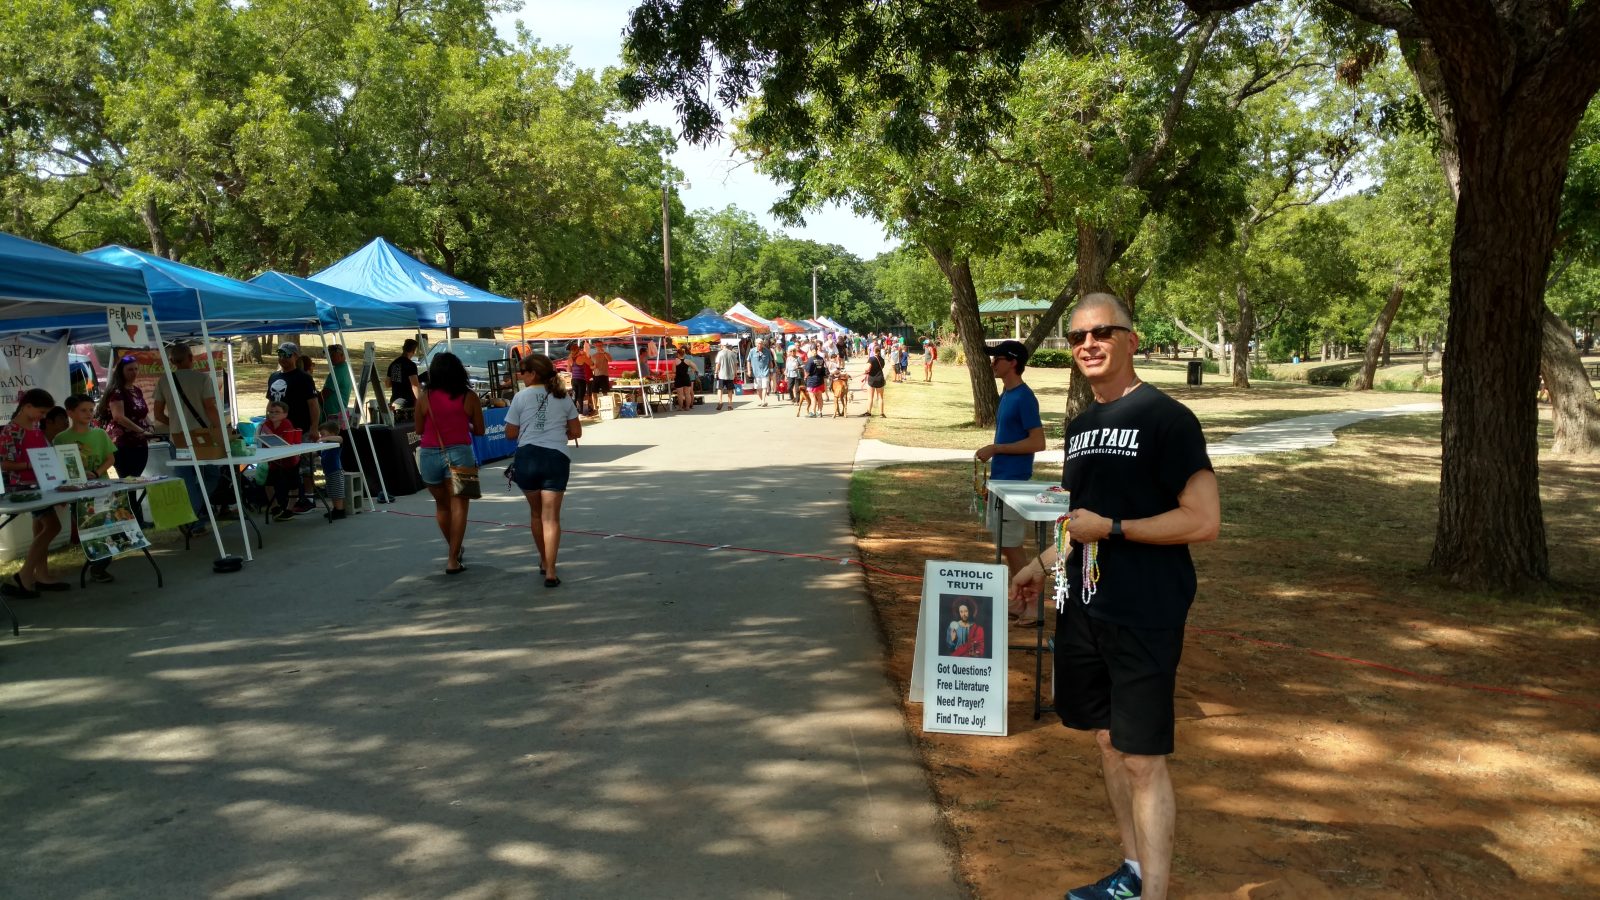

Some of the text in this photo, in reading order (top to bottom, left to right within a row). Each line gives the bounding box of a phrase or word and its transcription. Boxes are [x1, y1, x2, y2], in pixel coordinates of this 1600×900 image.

[1069, 428, 1139, 454] SAINT PAUL
[1081, 448, 1137, 456] EVANGELIZATION
[939, 568, 993, 580] CATHOLIC
[947, 580, 983, 590] TRUTH
[937, 663, 991, 676] Got Questions?
[937, 679, 989, 692] Free Literature
[936, 695, 985, 710] Need Prayer?
[936, 713, 986, 728] Find True Joy!
